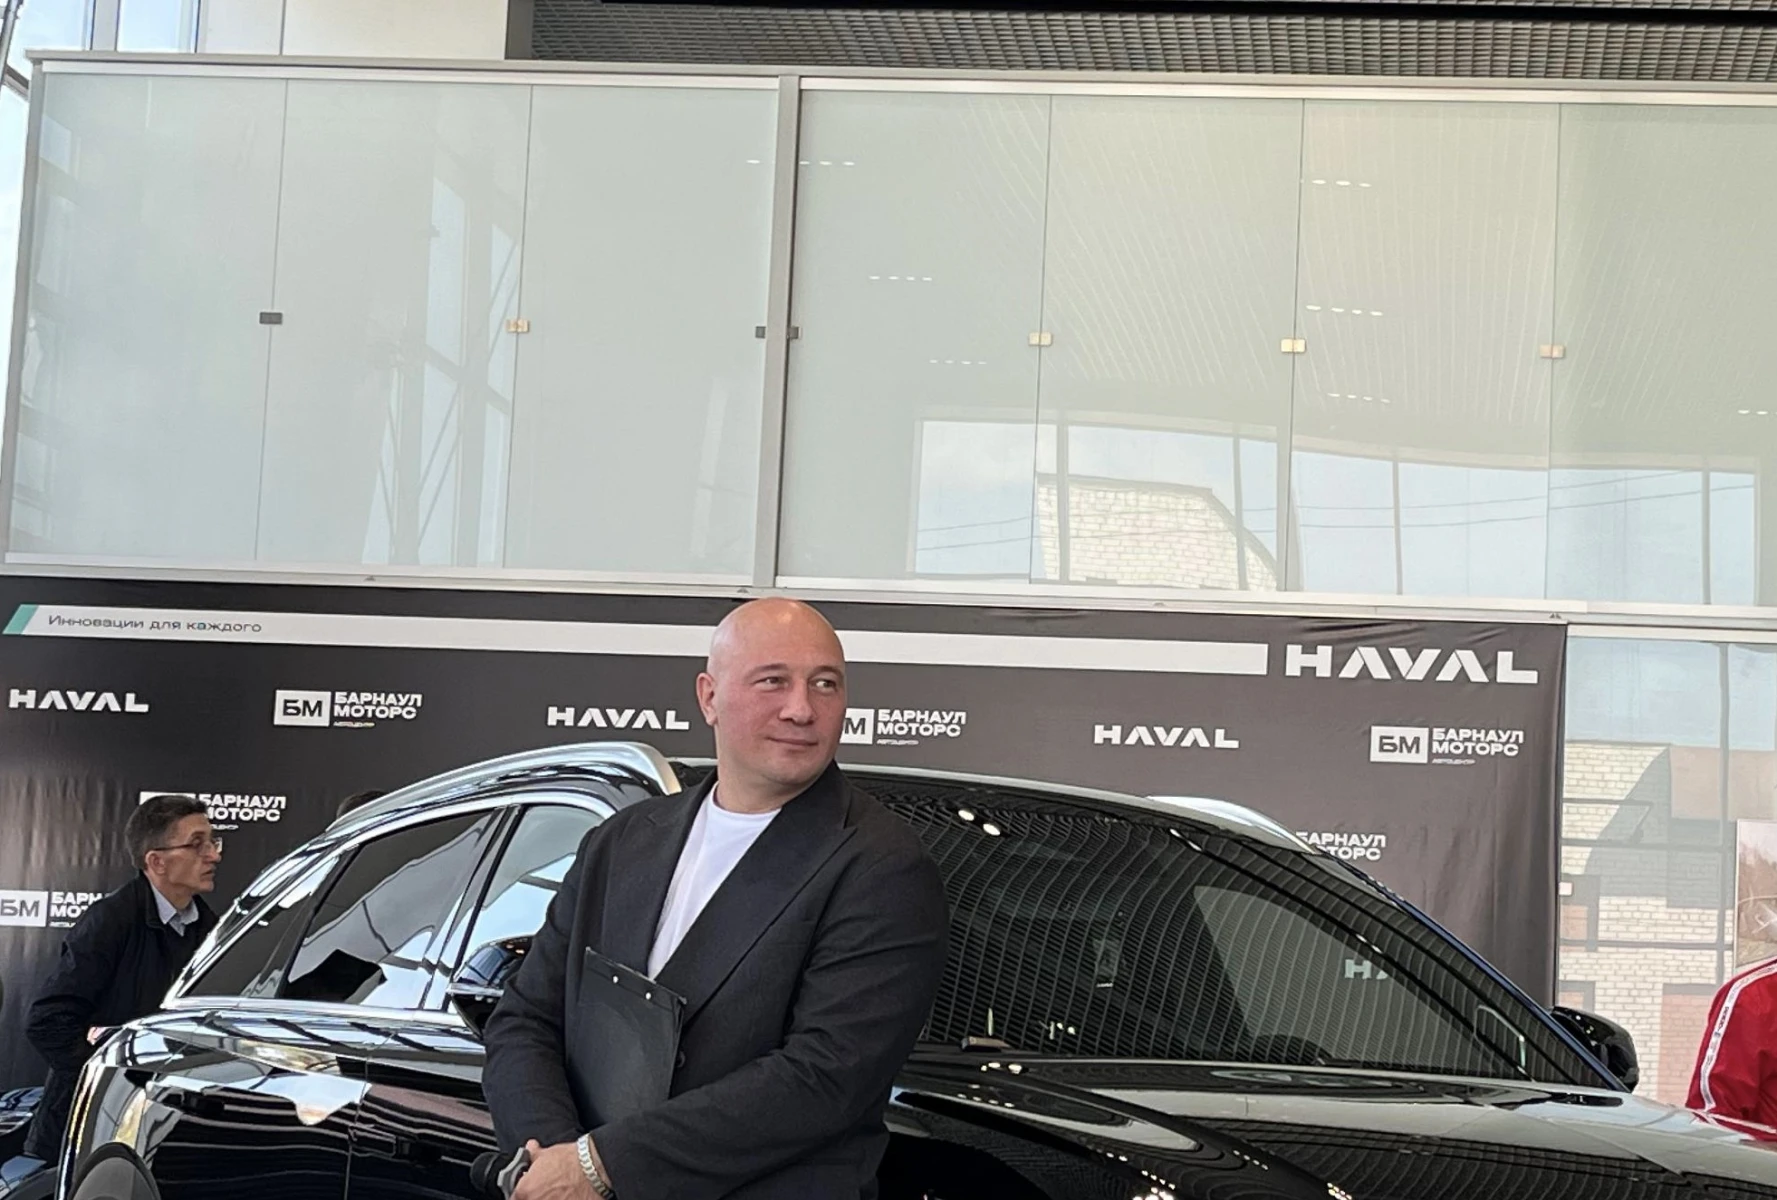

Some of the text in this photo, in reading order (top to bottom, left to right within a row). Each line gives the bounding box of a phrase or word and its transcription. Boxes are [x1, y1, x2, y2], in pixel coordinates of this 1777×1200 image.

[48, 614, 262, 633] Инновации для каждого
[1285, 644, 1539, 684] HAVAL
[9, 688, 149, 713] HAVAL
[335, 691, 422, 707] БАРНАУЛ
[282, 699, 323, 717] БМ
[333, 704, 417, 719] МОТОРС
[547, 706, 690, 730] HAVAL
[877, 709, 967, 725] БАРНАУЛ
[844, 717, 867, 735] М
[876, 722, 961, 738] МОТОРС
[1094, 724, 1240, 749] HAVAL
[1432, 727, 1524, 743] БАРНАУЛ
[1379, 735, 1421, 754] БМ
[1431, 741, 1519, 757] МОТОРС
[199, 793, 287, 809] БАРНАУЛ
[1317, 845, 1381, 861] ТОРС
